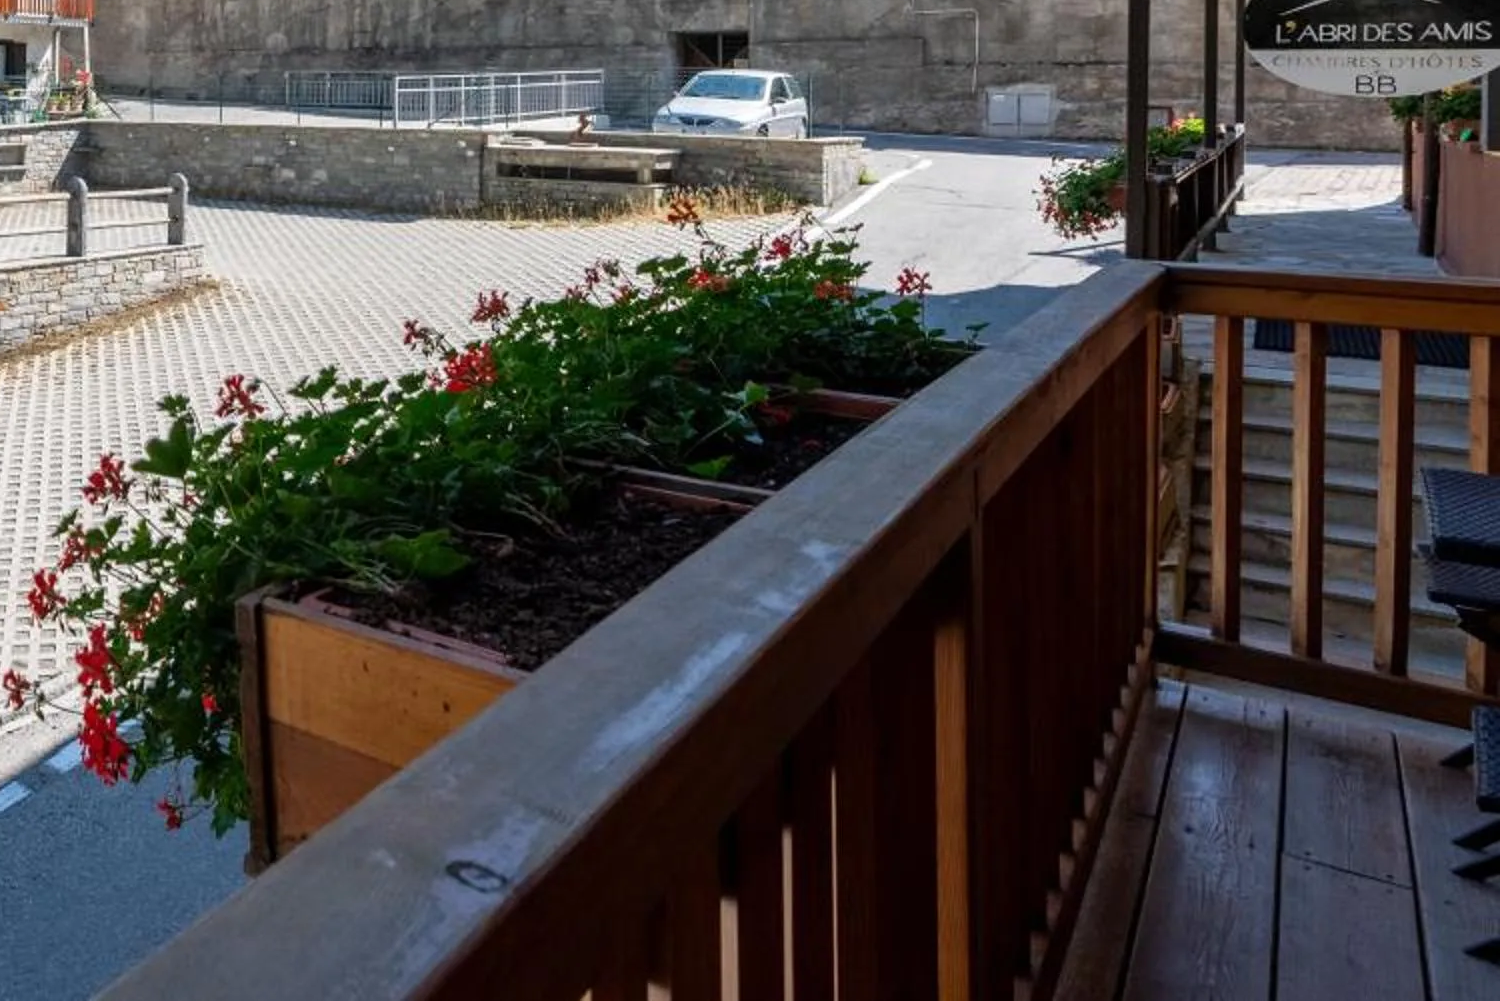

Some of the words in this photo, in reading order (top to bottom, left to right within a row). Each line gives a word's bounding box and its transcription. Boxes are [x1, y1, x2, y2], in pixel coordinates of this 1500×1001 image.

[1275, 21, 1356, 43] L'ABRI
[1363, 22, 1413, 42] DES
[1419, 21, 1493, 42] AMIS
[1355, 75, 1397, 94] BB
